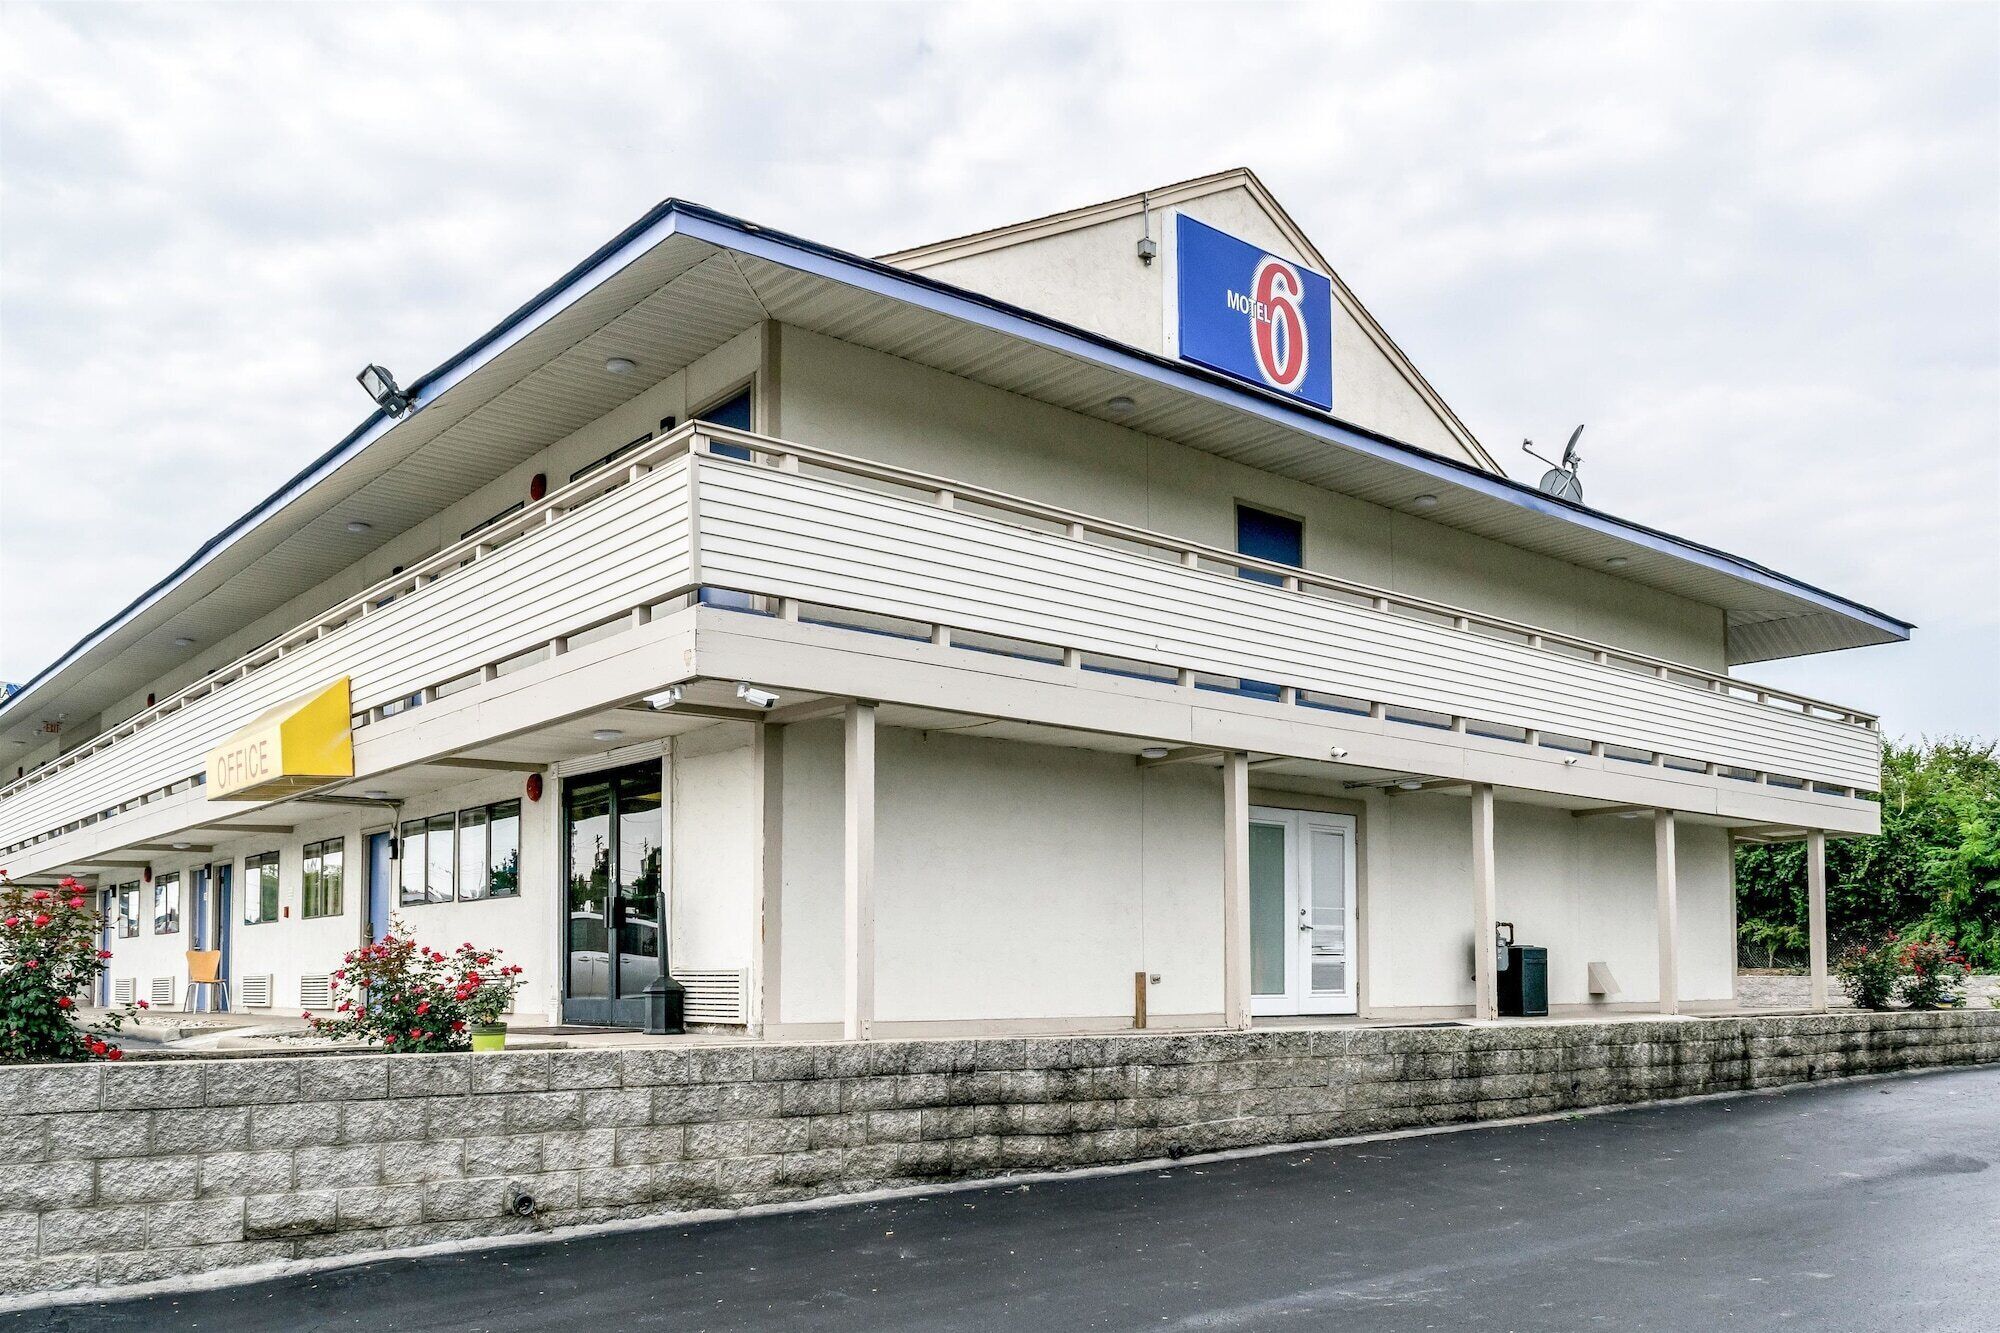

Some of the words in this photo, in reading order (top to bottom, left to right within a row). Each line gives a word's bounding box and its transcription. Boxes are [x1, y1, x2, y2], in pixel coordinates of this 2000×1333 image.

[1227, 289, 1271, 324] MOTEL
[1255, 261, 1305, 386] 6
[217, 740, 269, 789] OFFICE
